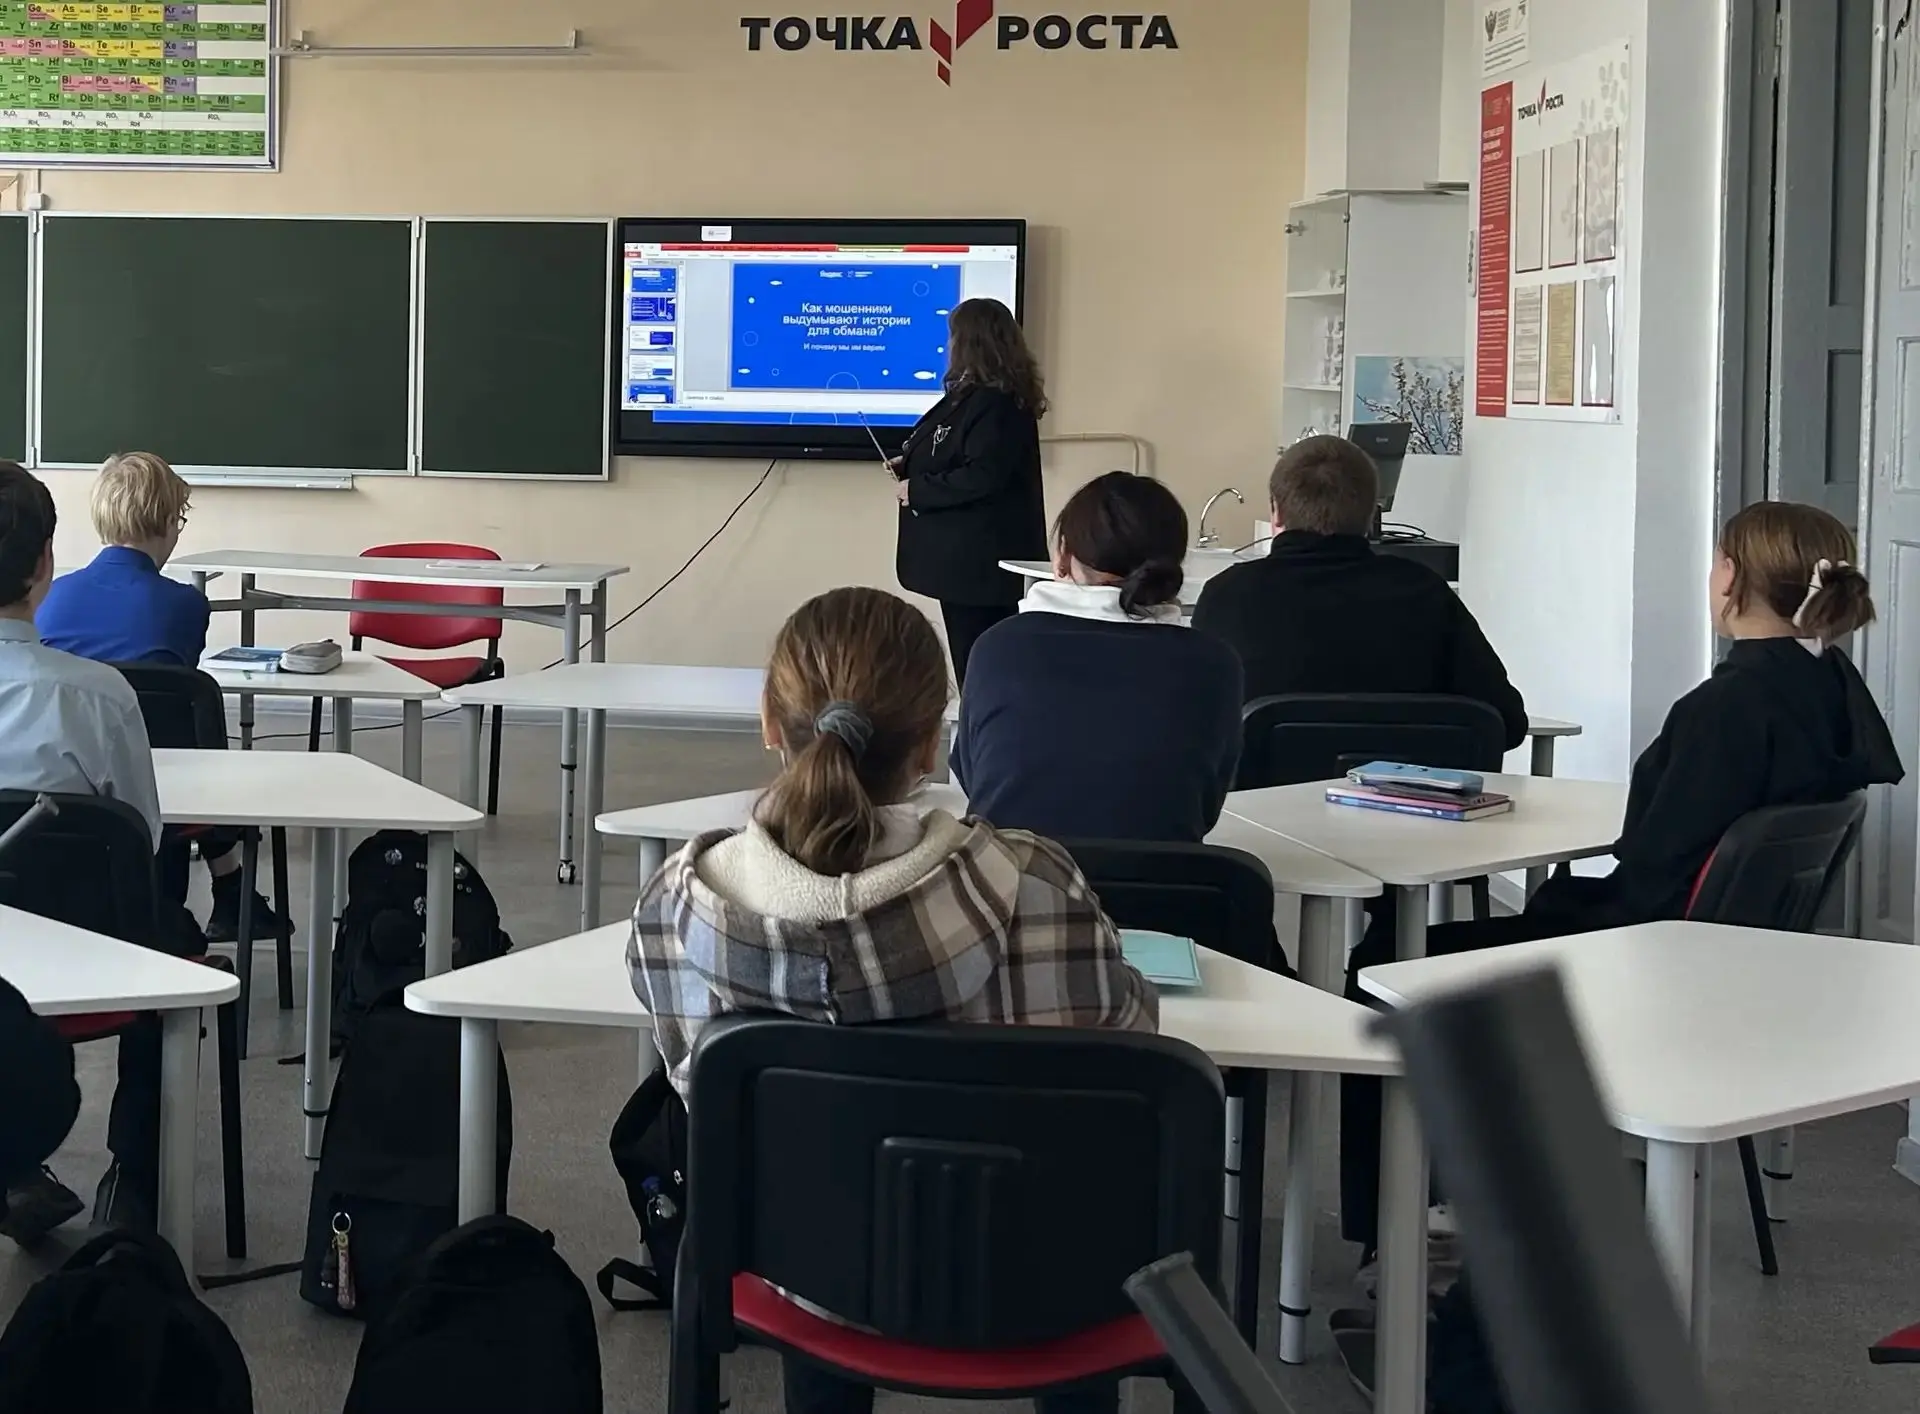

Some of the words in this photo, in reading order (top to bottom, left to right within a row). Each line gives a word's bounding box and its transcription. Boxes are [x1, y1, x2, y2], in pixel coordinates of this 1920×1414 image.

[28, 4, 41, 12] Ge
[62, 4, 75, 13] As
[96, 5, 108, 13] Se
[130, 5, 141, 13] Br
[165, 6, 176, 14] Kr
[19, 21, 25, 30] Y
[49, 22, 60, 30] Zr
[81, 22, 94, 30] Nb
[113, 22, 128, 31] Mo
[183, 23, 195, 32] Ru
[740, 16, 922, 51] ТОЧКА
[997, 15, 1179, 50] РОСТА
[28, 40, 41, 48] Sn
[62, 40, 75, 49] Sb
[97, 40, 108, 49] Te
[165, 41, 176, 50] Xe
[83, 58, 94, 67] Ta
[118, 58, 128, 67] W
[182, 59, 195, 68] Os
[28, 75, 41, 83] Pb
[96, 76, 109, 84] Po
[130, 76, 141, 85] At
[164, 76, 177, 85] Rn
[80, 93, 94, 102] Db
[182, 95, 195, 103] Hs
[802, 303, 823, 313] Как
[825, 305, 892, 314] мошенники
[783, 315, 859, 326] выдумывают
[862, 316, 911, 327] истории
[807, 326, 830, 337] для
[833, 325, 885, 336] обмана?
